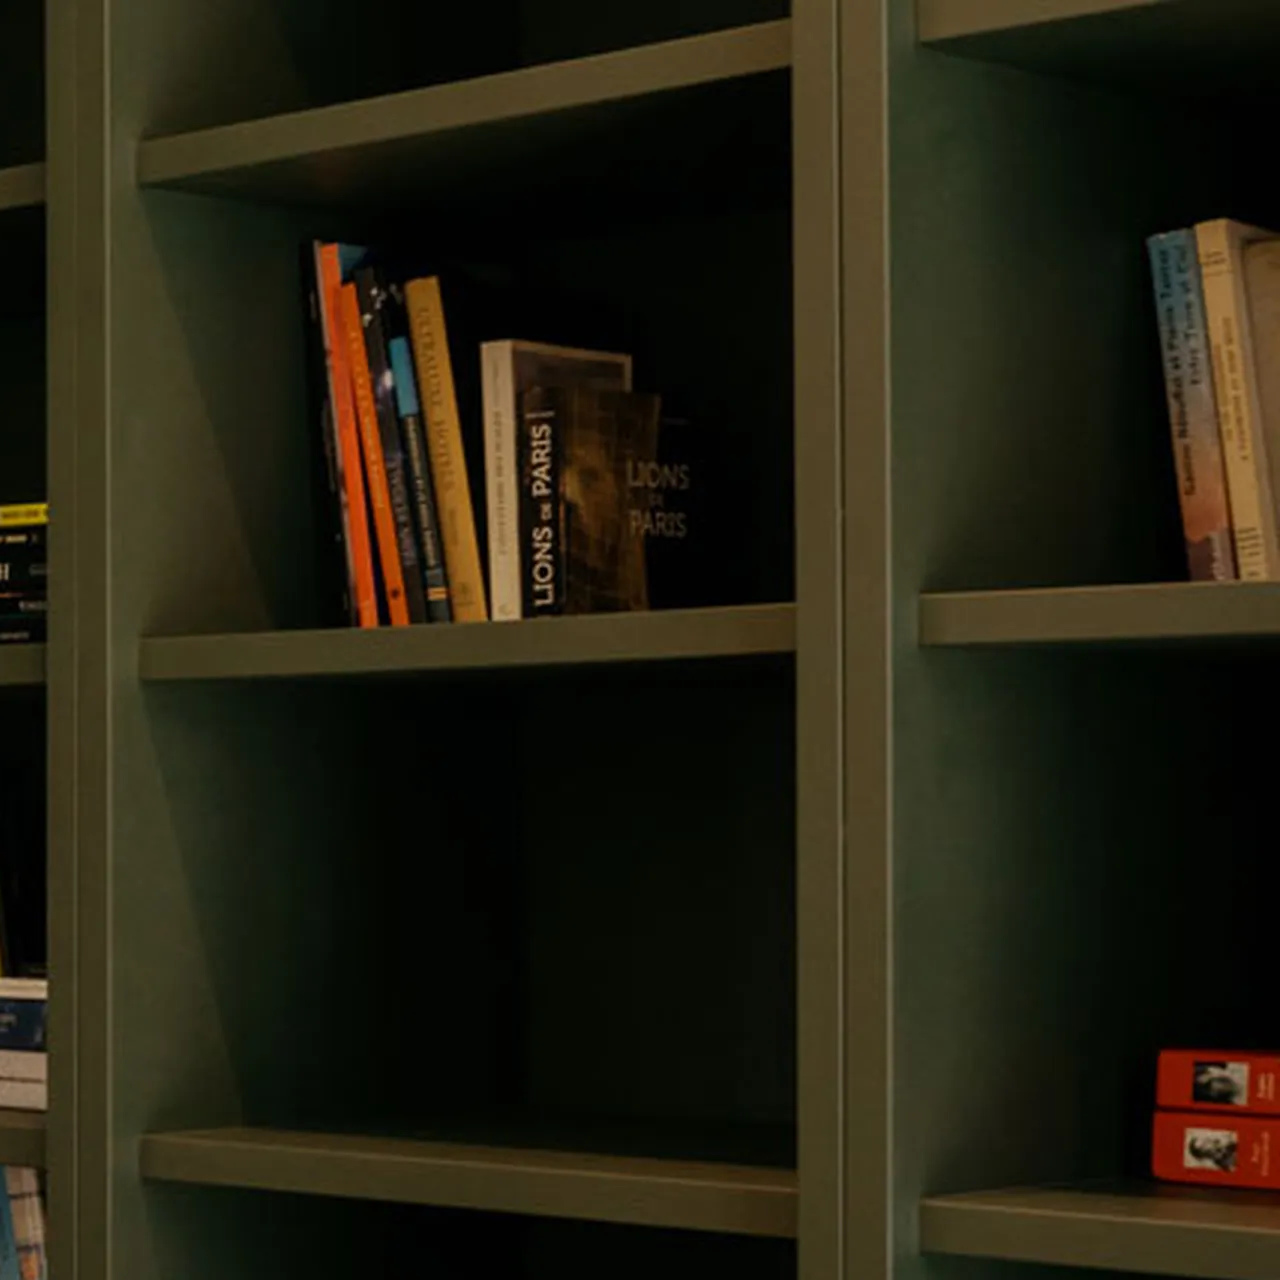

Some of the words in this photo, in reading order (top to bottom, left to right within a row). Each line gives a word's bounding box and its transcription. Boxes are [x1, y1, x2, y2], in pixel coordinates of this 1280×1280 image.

[531, 422, 555, 500] PARIS
[625, 457, 692, 492] LIONS
[628, 507, 689, 540] PARIS
[532, 525, 555, 608] LIONS
